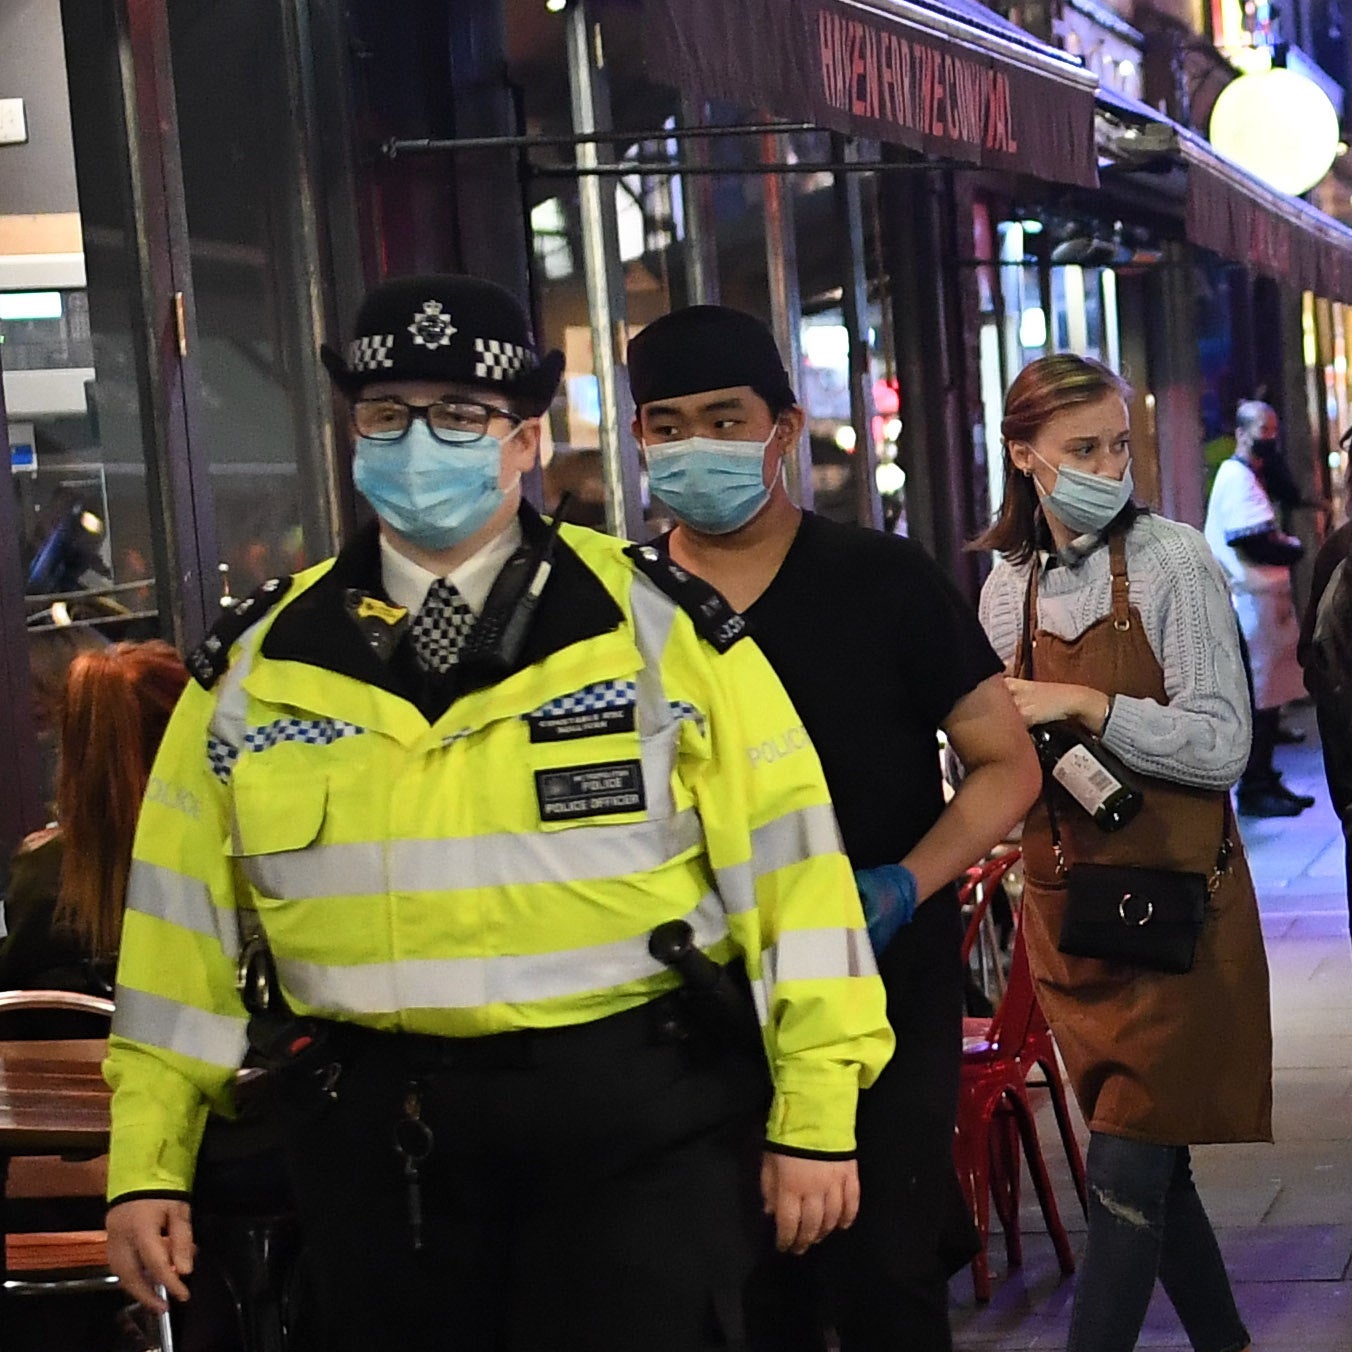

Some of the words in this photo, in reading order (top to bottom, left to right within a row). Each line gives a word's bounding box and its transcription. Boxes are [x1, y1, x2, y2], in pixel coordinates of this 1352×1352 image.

[819, 9, 880, 119] HAVEN
[881, 32, 914, 129] FOR
[913, 43, 944, 137] THE
[581, 777, 622, 792] POLICE
[544, 800, 586, 814] POLICE
[590, 793, 640, 809] OFFICER
